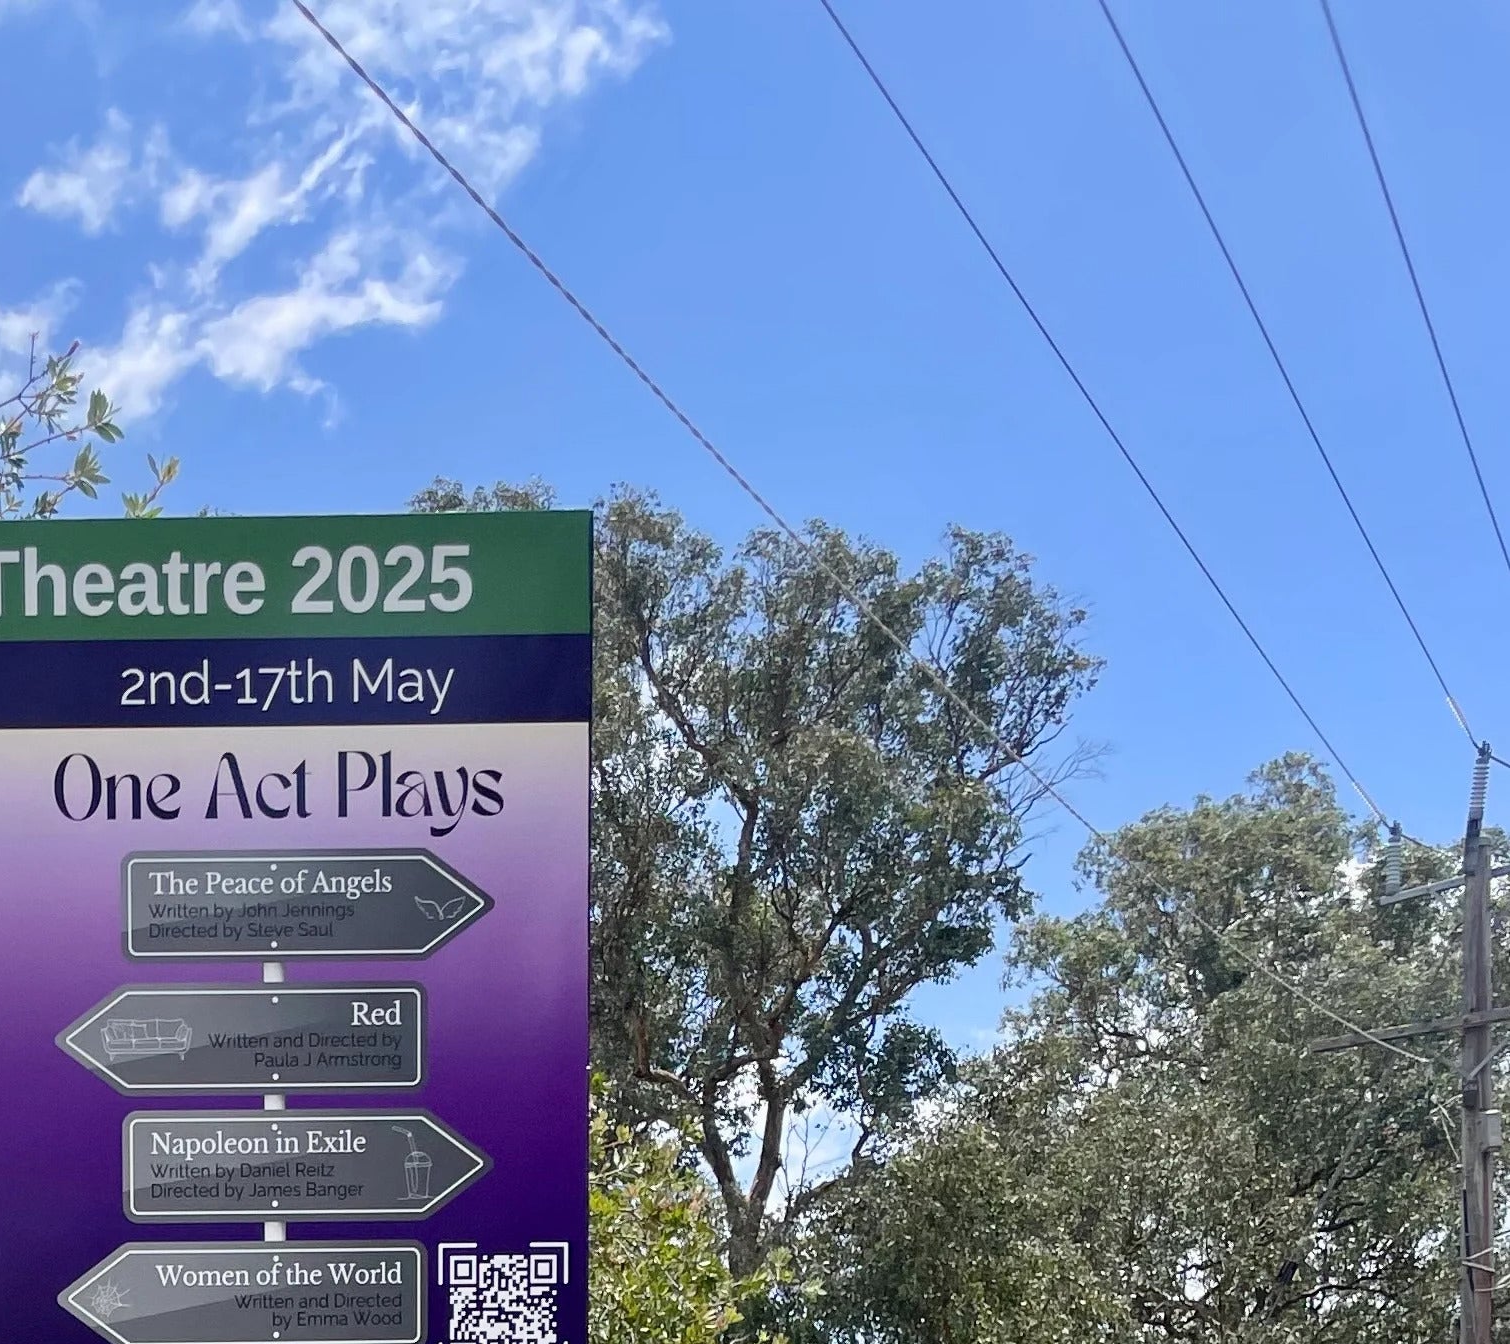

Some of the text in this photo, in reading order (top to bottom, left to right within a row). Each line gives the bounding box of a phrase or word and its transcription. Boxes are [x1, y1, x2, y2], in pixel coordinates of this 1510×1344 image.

[292, 545, 472, 613] 2025
[121, 658, 454, 714] 2nd-17th May
[52, 749, 505, 838] One Act Plays
[149, 869, 392, 897] The Peace of Angels
[148, 901, 355, 921] Written by John Jennings
[149, 921, 333, 941] Directed by Steve Saul
[351, 1001, 402, 1025] Red
[206, 1032, 402, 1050] Written and Directed by
[254, 1052, 402, 1070] Paula J Armstrong
[151, 1131, 366, 1160] Napoleon in Exile
[150, 1162, 336, 1182] Written by Daniel Reitz
[149, 1181, 364, 1201] Directed by James Banger
[156, 1263, 402, 1286] Women of the World
